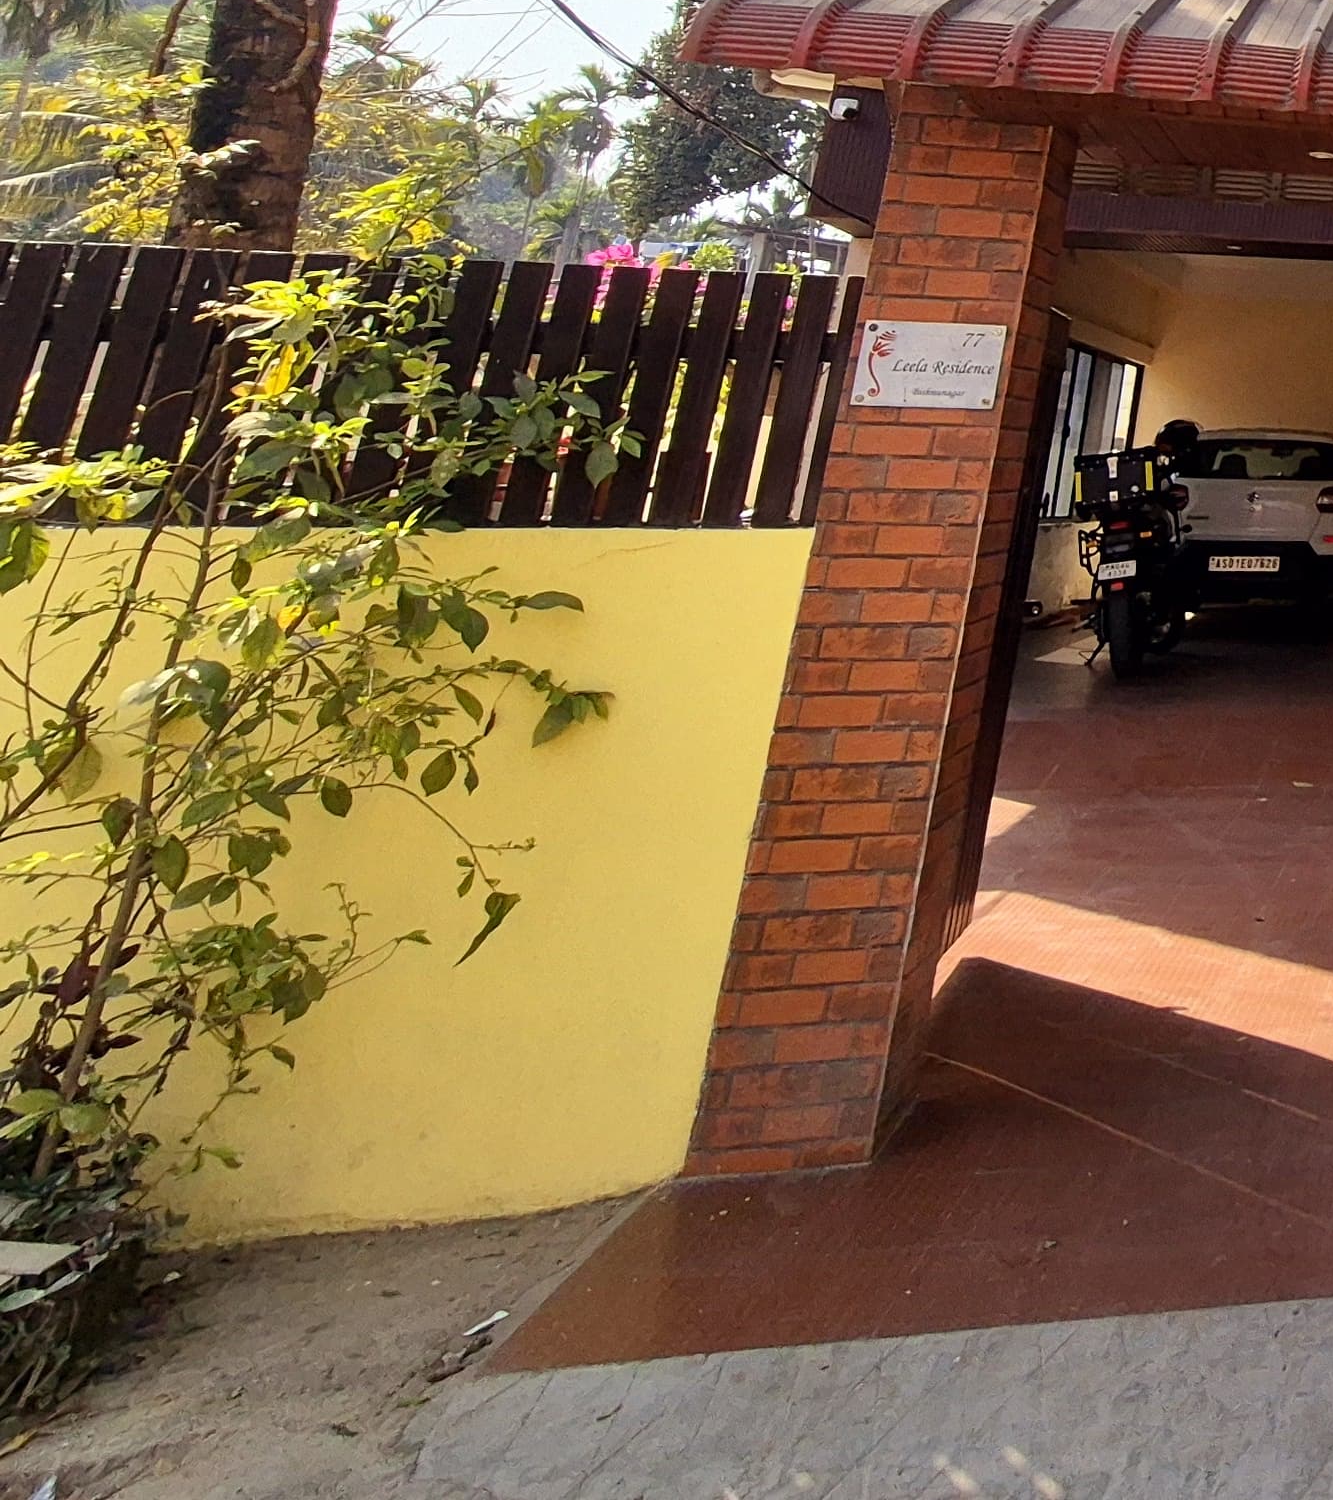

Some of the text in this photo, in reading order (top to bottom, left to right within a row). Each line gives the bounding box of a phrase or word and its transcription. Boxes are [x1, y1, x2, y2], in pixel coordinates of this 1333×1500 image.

[962, 332, 986, 348] 77
[893, 358, 995, 376] Leela Residence
